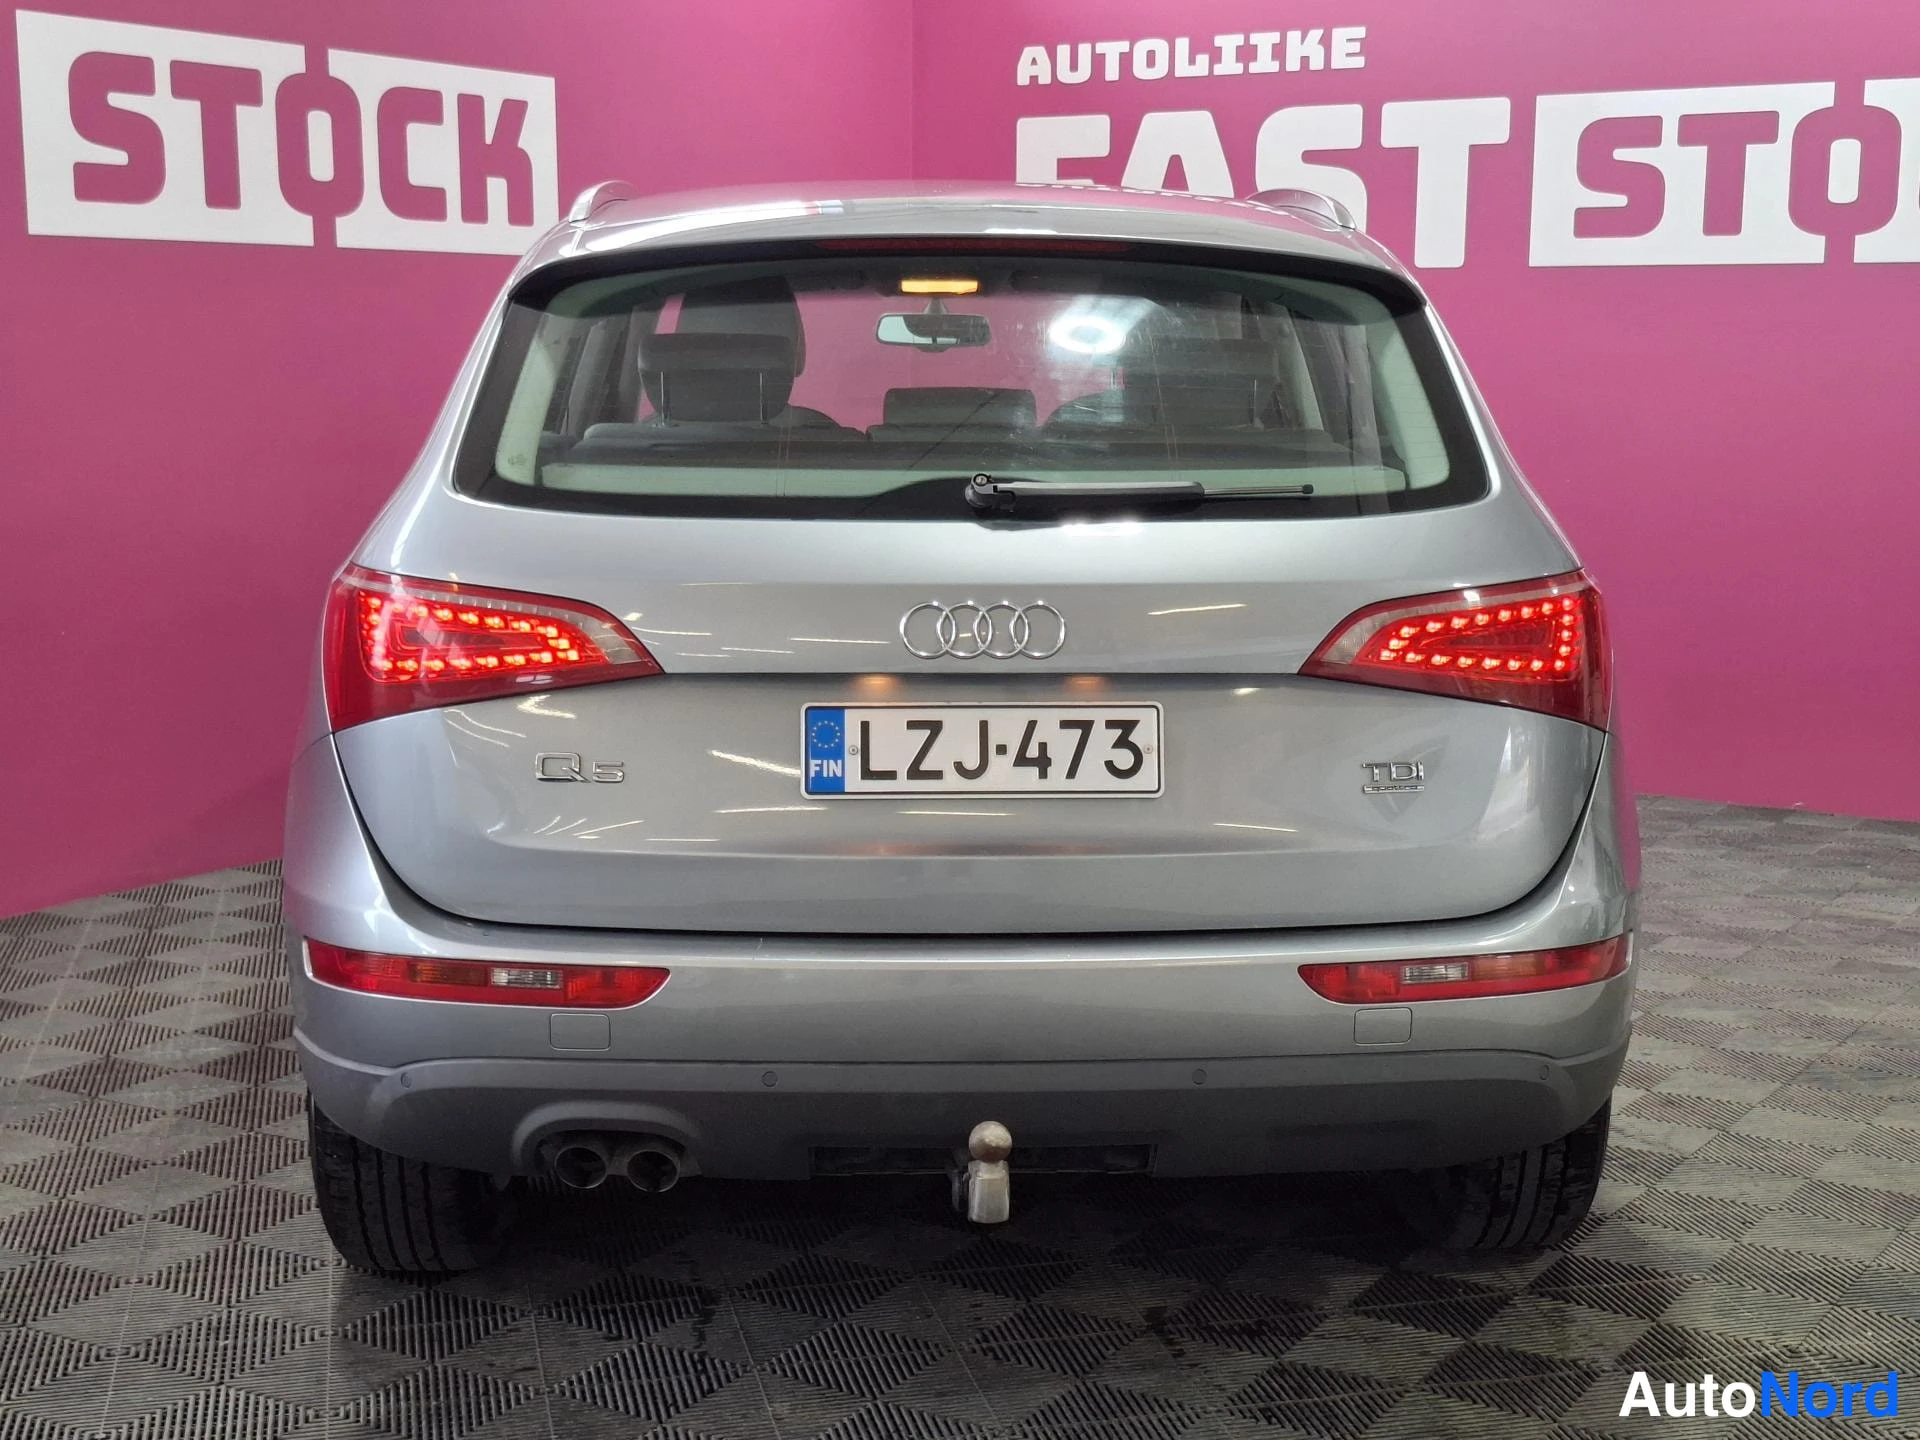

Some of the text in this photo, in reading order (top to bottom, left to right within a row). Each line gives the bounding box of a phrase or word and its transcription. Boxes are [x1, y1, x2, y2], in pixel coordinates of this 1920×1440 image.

[1017, 26, 1366, 86] AUTOLIIKE
[68, 50, 534, 227] STOCK
[1573, 105, 1920, 239] STO
[535, 752, 625, 784] Q5
[810, 759, 843, 778] FIN
[860, 720, 1144, 780] LZJ-473
